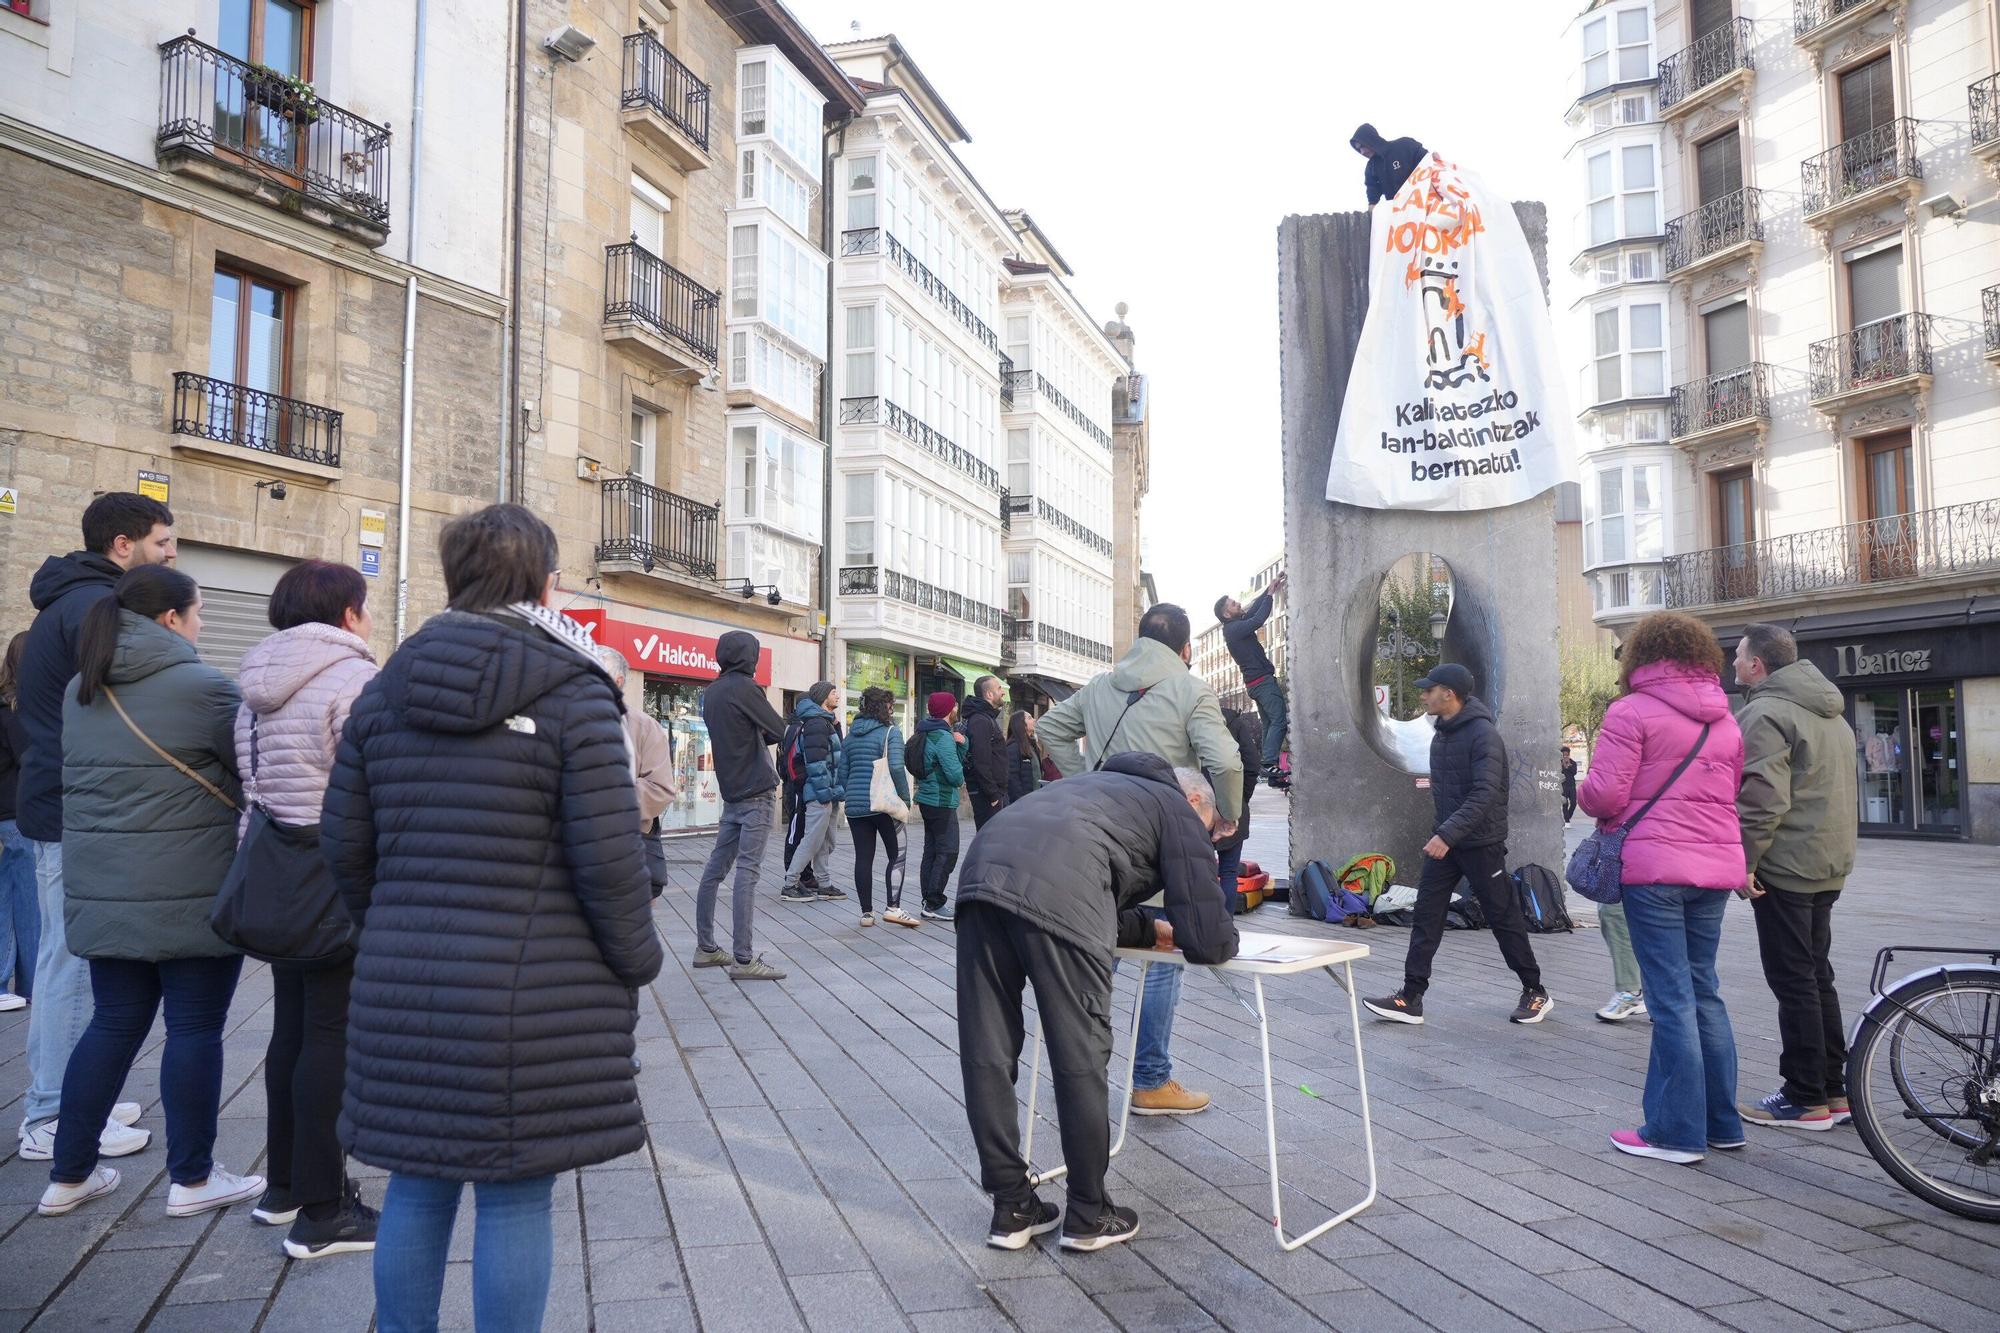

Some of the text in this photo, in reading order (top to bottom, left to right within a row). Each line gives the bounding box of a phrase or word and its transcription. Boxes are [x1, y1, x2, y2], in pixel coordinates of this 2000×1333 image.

[1381, 410, 1541, 453] lan-baldintzak
[1411, 448, 1522, 481] bermatu!
[658, 642, 706, 669] Halcón
